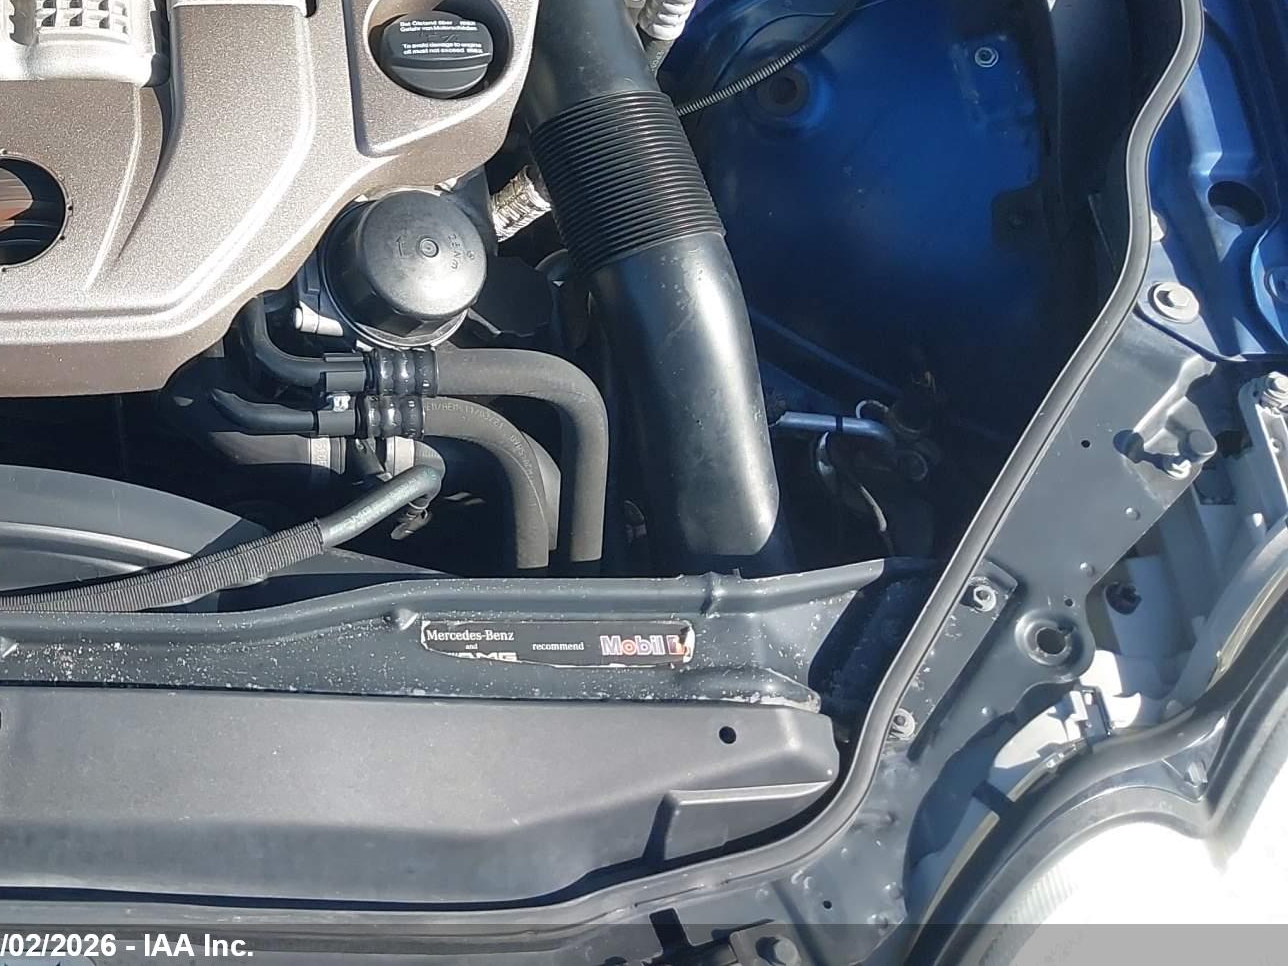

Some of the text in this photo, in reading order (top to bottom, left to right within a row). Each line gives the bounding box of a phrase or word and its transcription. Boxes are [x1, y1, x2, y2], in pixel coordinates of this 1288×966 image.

[426, 629, 515, 641] Mercedes-Benz
[532, 641, 584, 651] recommend
[600, 634, 666, 656] Mobil
